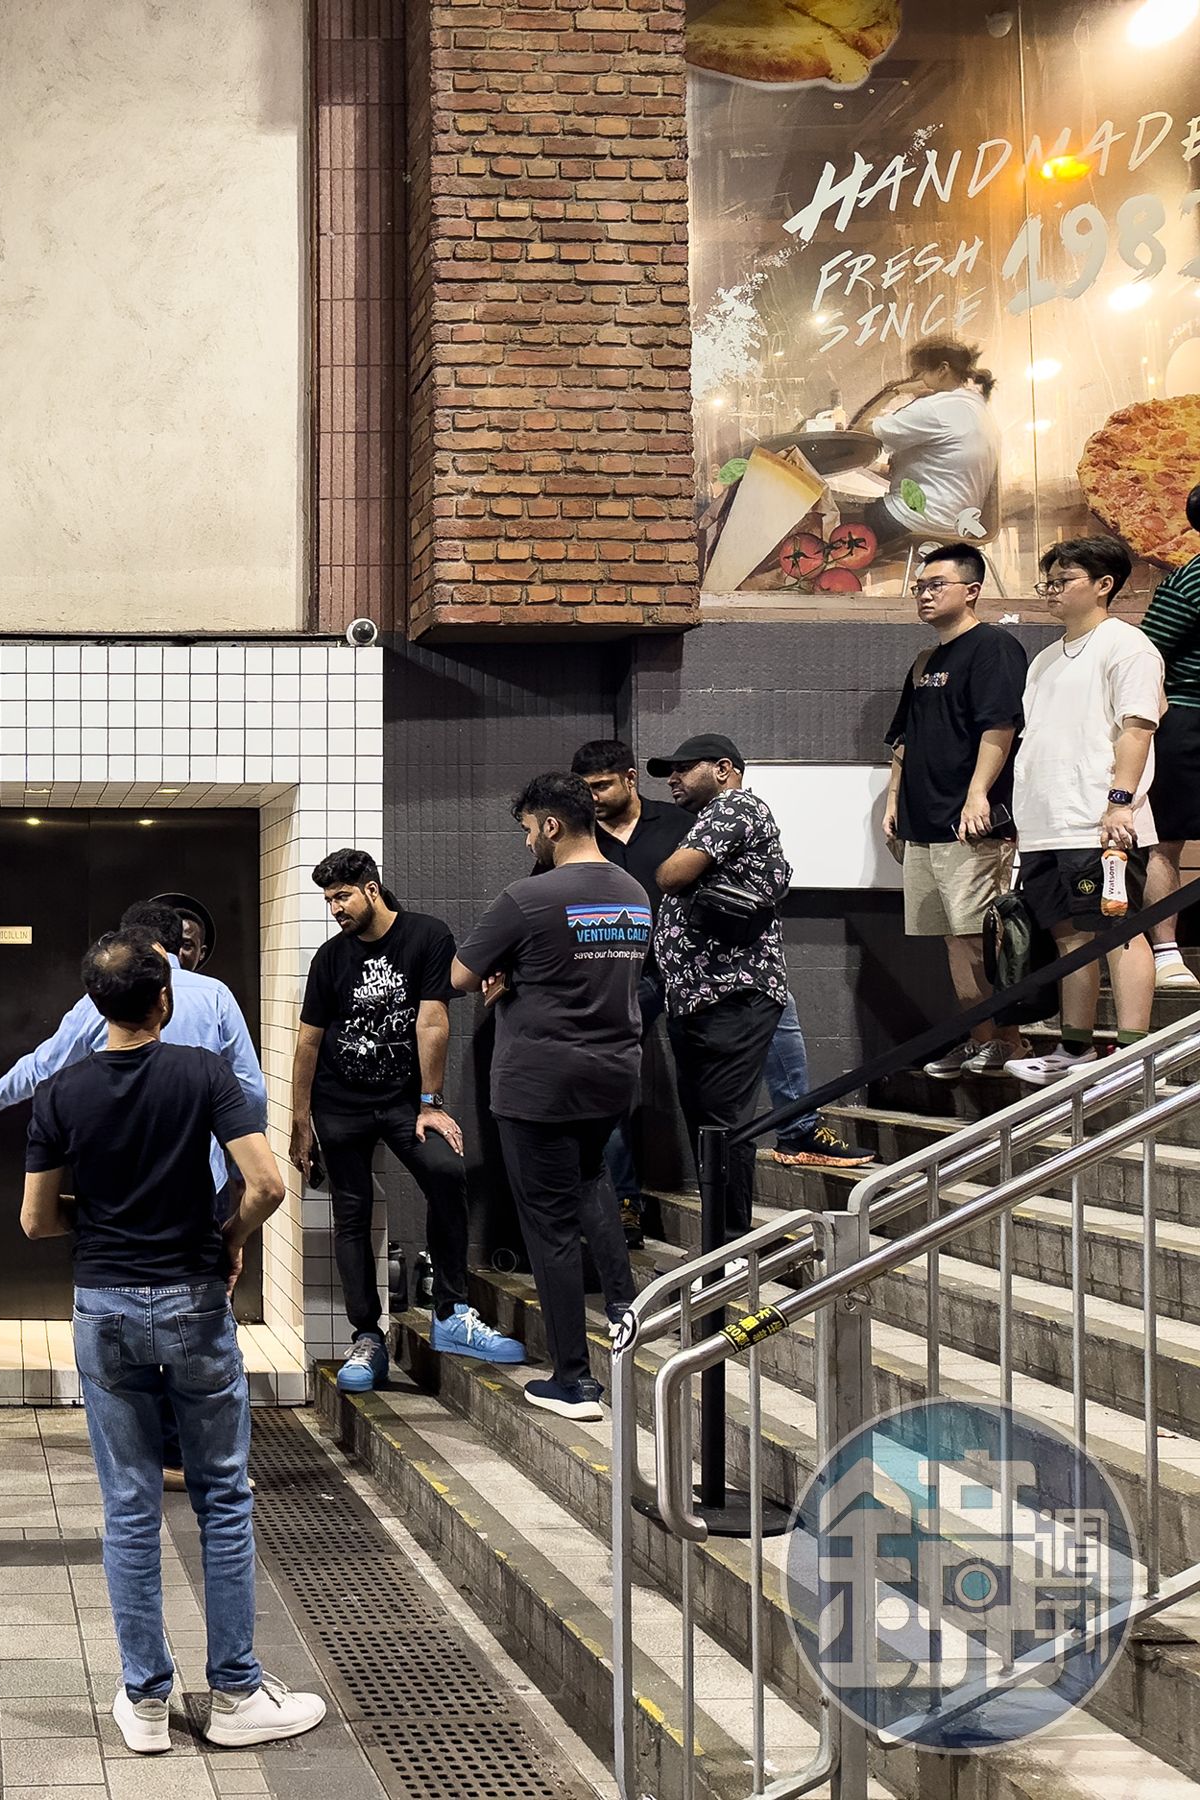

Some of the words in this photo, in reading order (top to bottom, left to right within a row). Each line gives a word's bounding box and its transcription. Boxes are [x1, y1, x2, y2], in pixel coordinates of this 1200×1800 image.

[813, 235, 984, 312] FRESH
[818, 285, 984, 353] SINCE
[576, 927, 626, 943] VENTURA
[364, 955, 388, 970] THE
[574, 951, 594, 960] save
[594, 951, 607, 959] our
[607, 949, 631, 958] home
